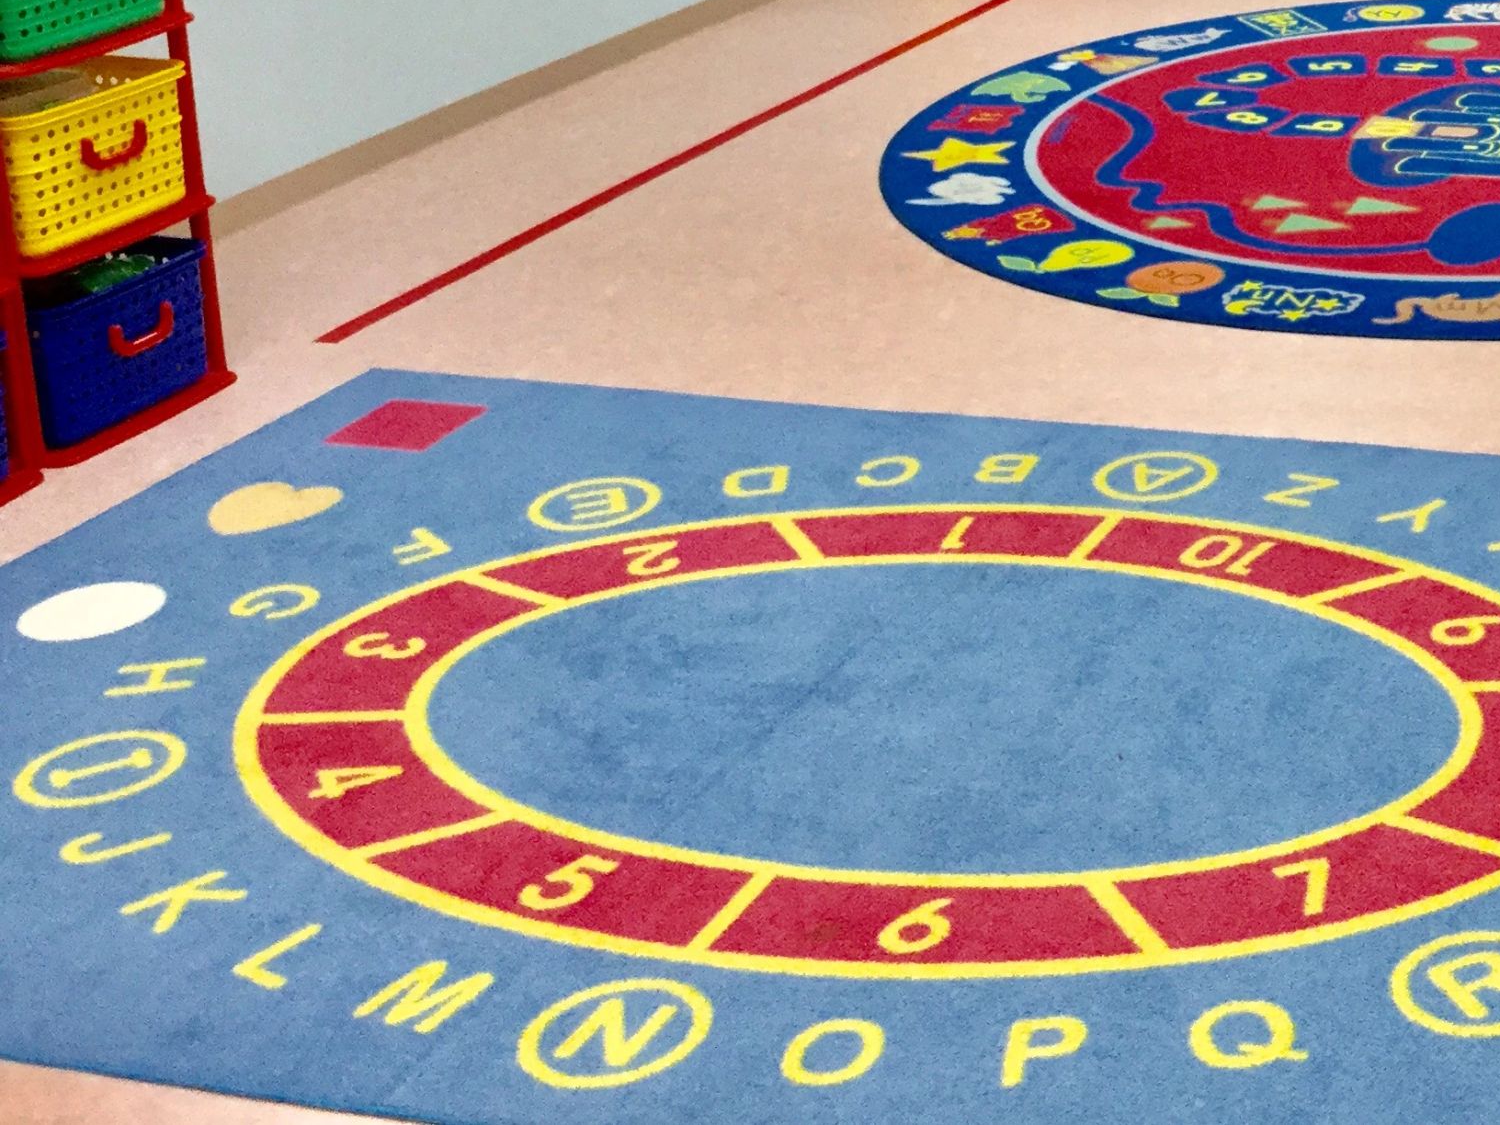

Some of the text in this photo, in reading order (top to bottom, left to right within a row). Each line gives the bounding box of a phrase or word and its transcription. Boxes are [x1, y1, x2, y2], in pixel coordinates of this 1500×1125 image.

[722, 465, 790, 497] D
[856, 455, 921, 488] C
[975, 453, 1040, 484] B
[1131, 461, 1194, 493] A
[569, 486, 628, 524] E
[1264, 473, 1340, 507] Z
[1377, 499, 1447, 532] Y
[392, 527, 452, 564] F
[940, 516, 975, 554] 1
[622, 540, 682, 576] 2
[1179, 534, 1278, 577] 10
[230, 584, 321, 620] G
[343, 631, 426, 660] 3
[103, 657, 207, 699] H
[50, 748, 153, 789] I
[309, 763, 405, 801] 4
[60, 832, 171, 864] J
[120, 870, 248, 933] K
[519, 855, 617, 911] 5
[1272, 857, 1330, 916] 7
[878, 898, 950, 954] 6
[233, 923, 322, 989] L
[354, 960, 494, 1034] M
[553, 997, 678, 1068] N
[1189, 1000, 1308, 1070] Q
[781, 1019, 886, 1087] O
[1002, 1016, 1089, 1088] P
